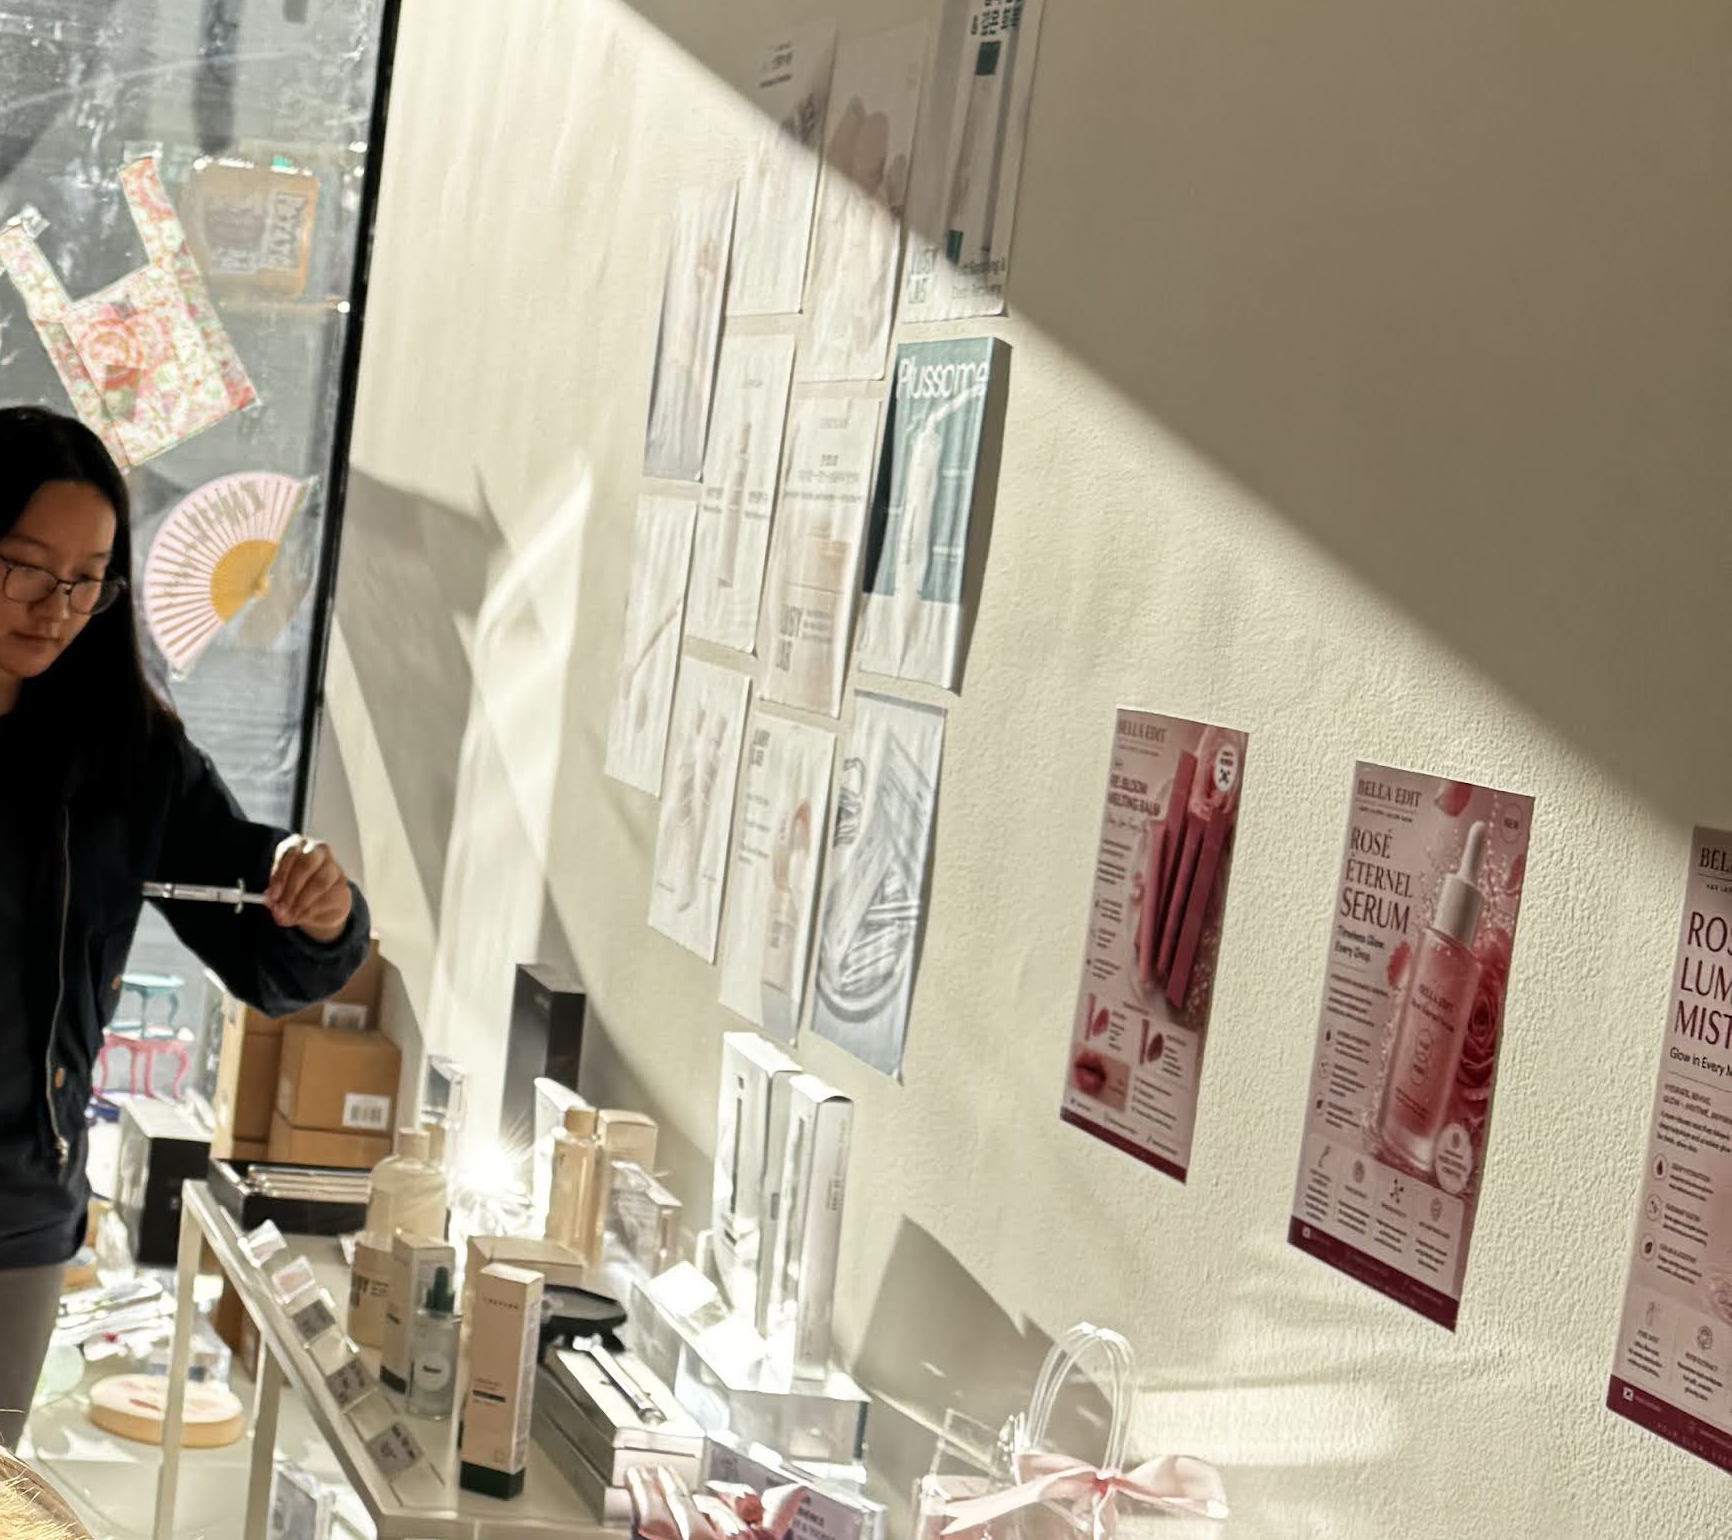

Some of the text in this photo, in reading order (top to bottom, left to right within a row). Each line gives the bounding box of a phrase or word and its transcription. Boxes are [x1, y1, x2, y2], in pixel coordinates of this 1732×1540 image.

[1357, 779, 1422, 807] BELLA EDIT
[1350, 826, 1394, 860] ROSÉ
[1699, 847, 1732, 873] BEL
[1340, 887, 1410, 935] SERUM
[1687, 911, 1732, 956] RO
[1674, 1000, 1732, 1049] MIST
[1670, 1047, 1725, 1077] Glow in Every
